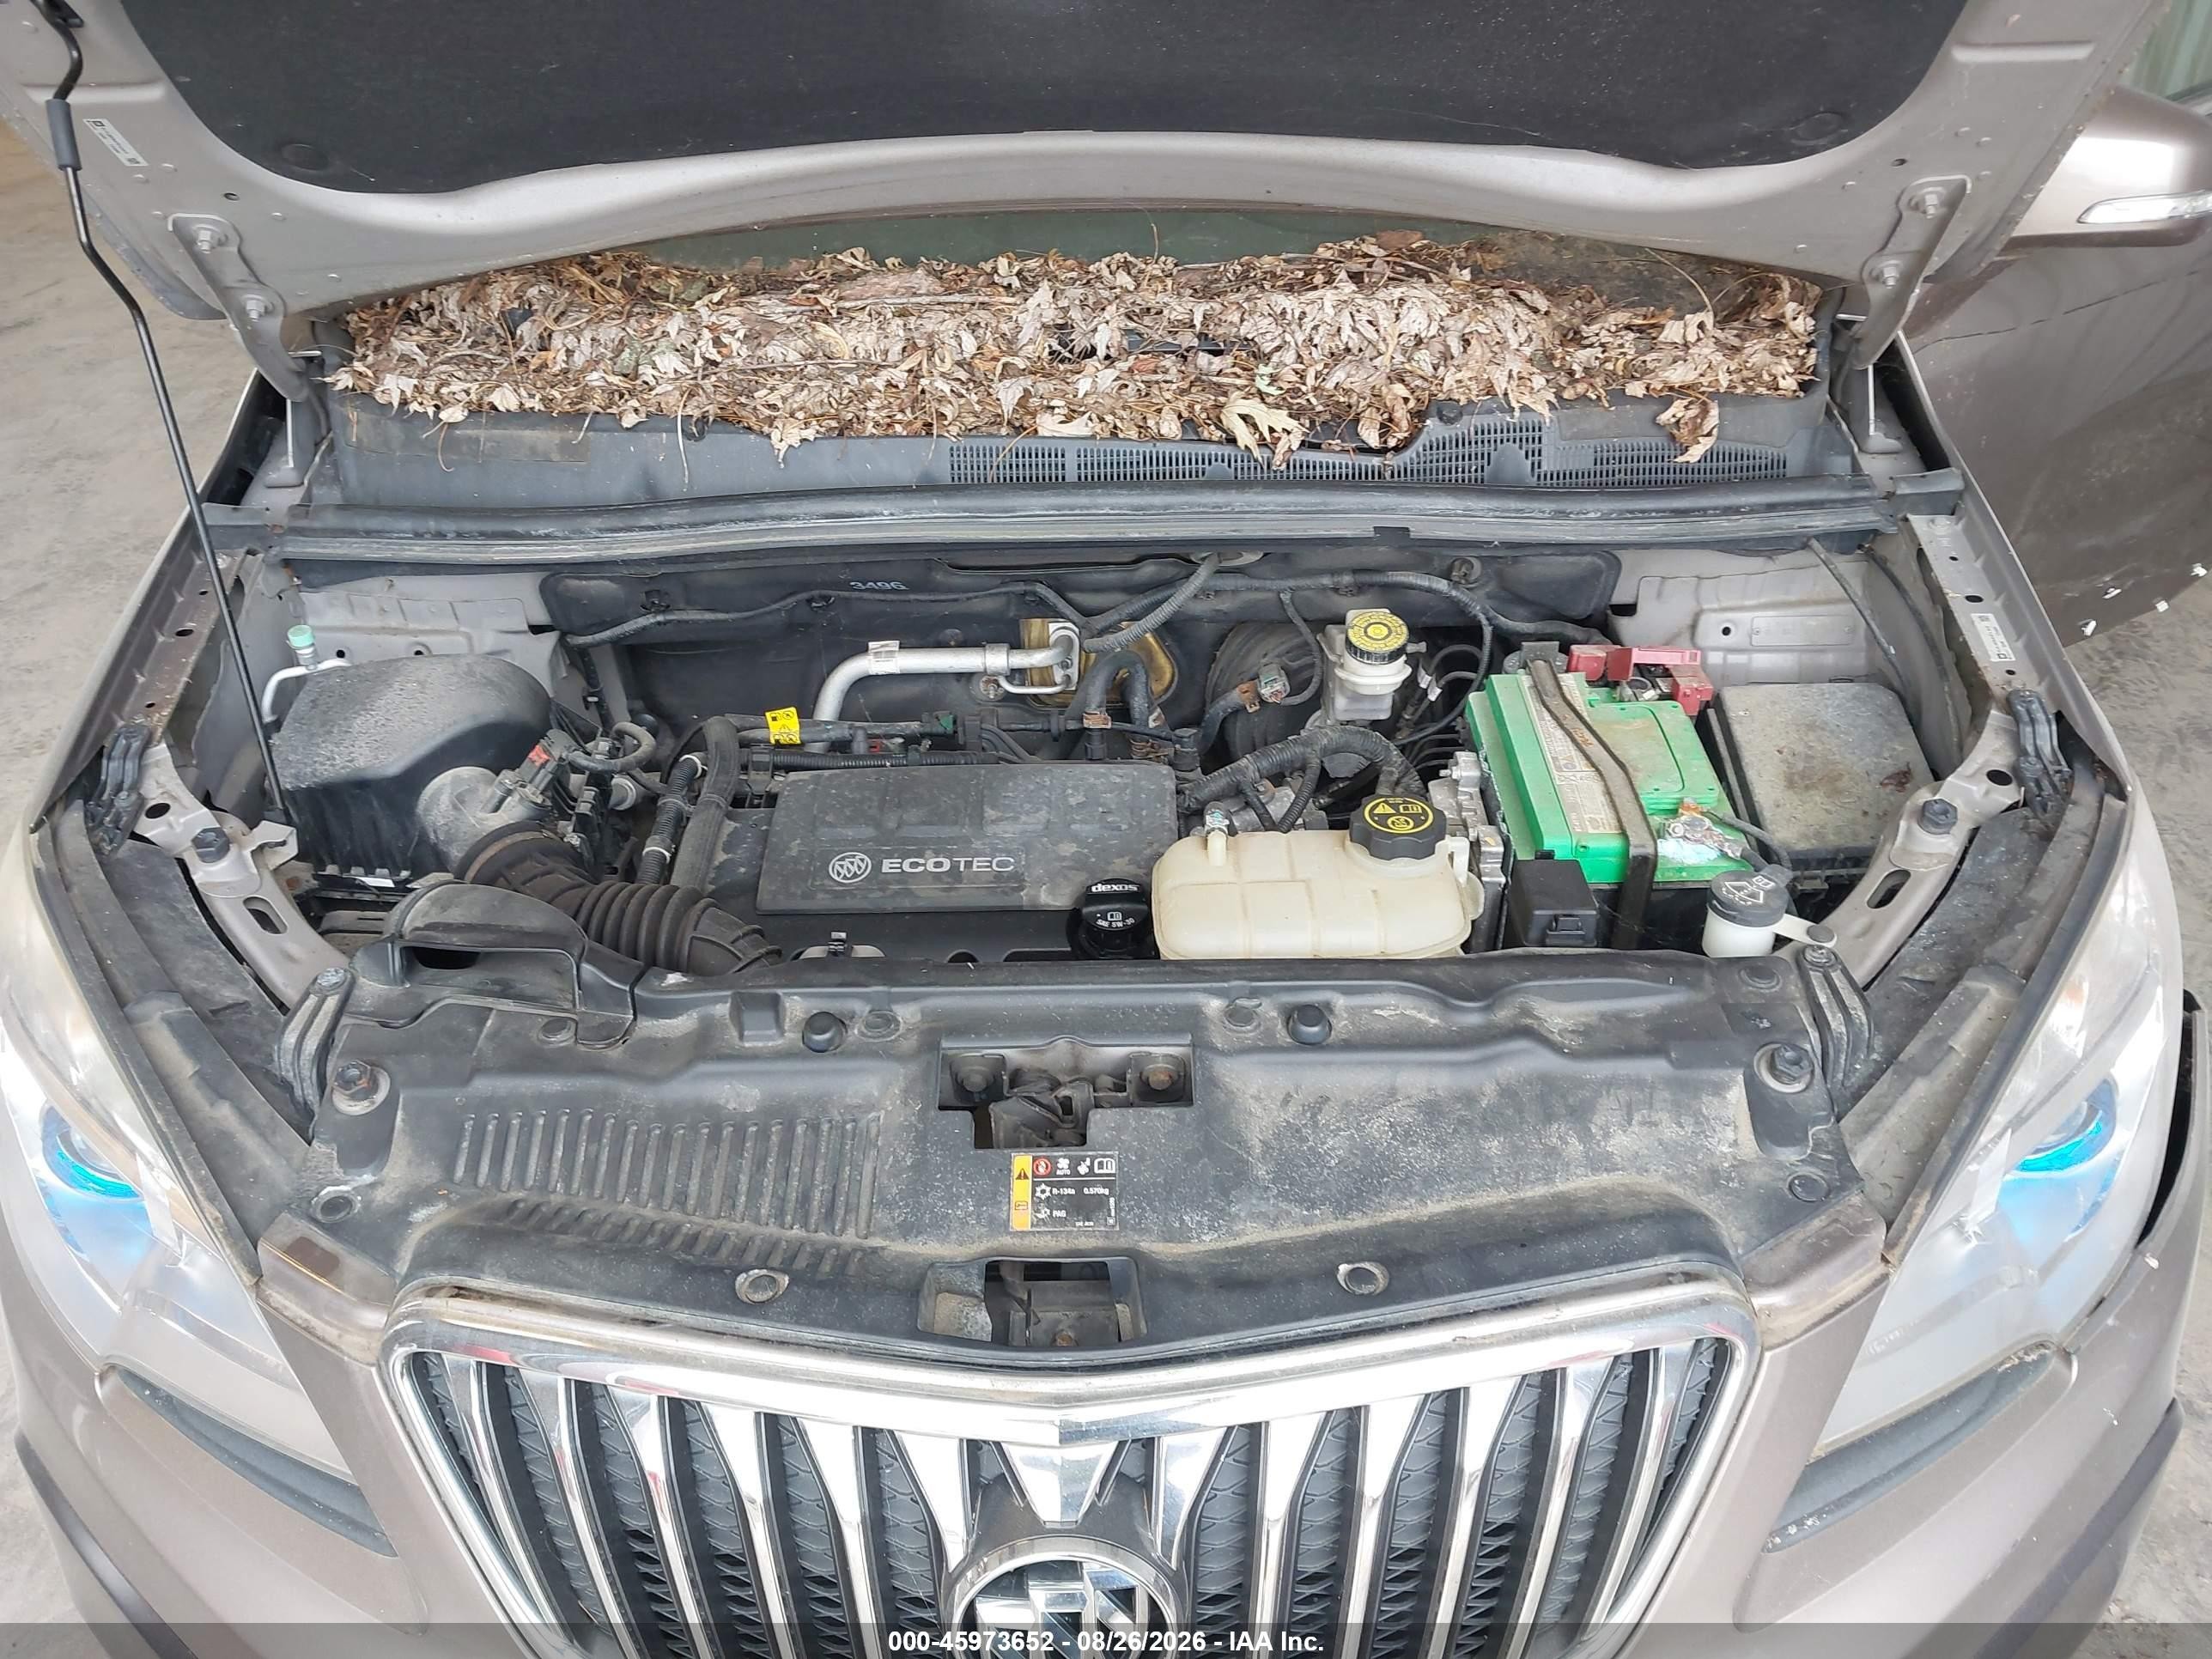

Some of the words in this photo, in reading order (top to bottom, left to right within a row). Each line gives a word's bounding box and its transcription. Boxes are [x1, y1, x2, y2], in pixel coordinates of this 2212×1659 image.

[849, 581, 909, 591] 3496
[881, 857, 1015, 873] ECOTEC
[1091, 883, 1139, 892] dexos
